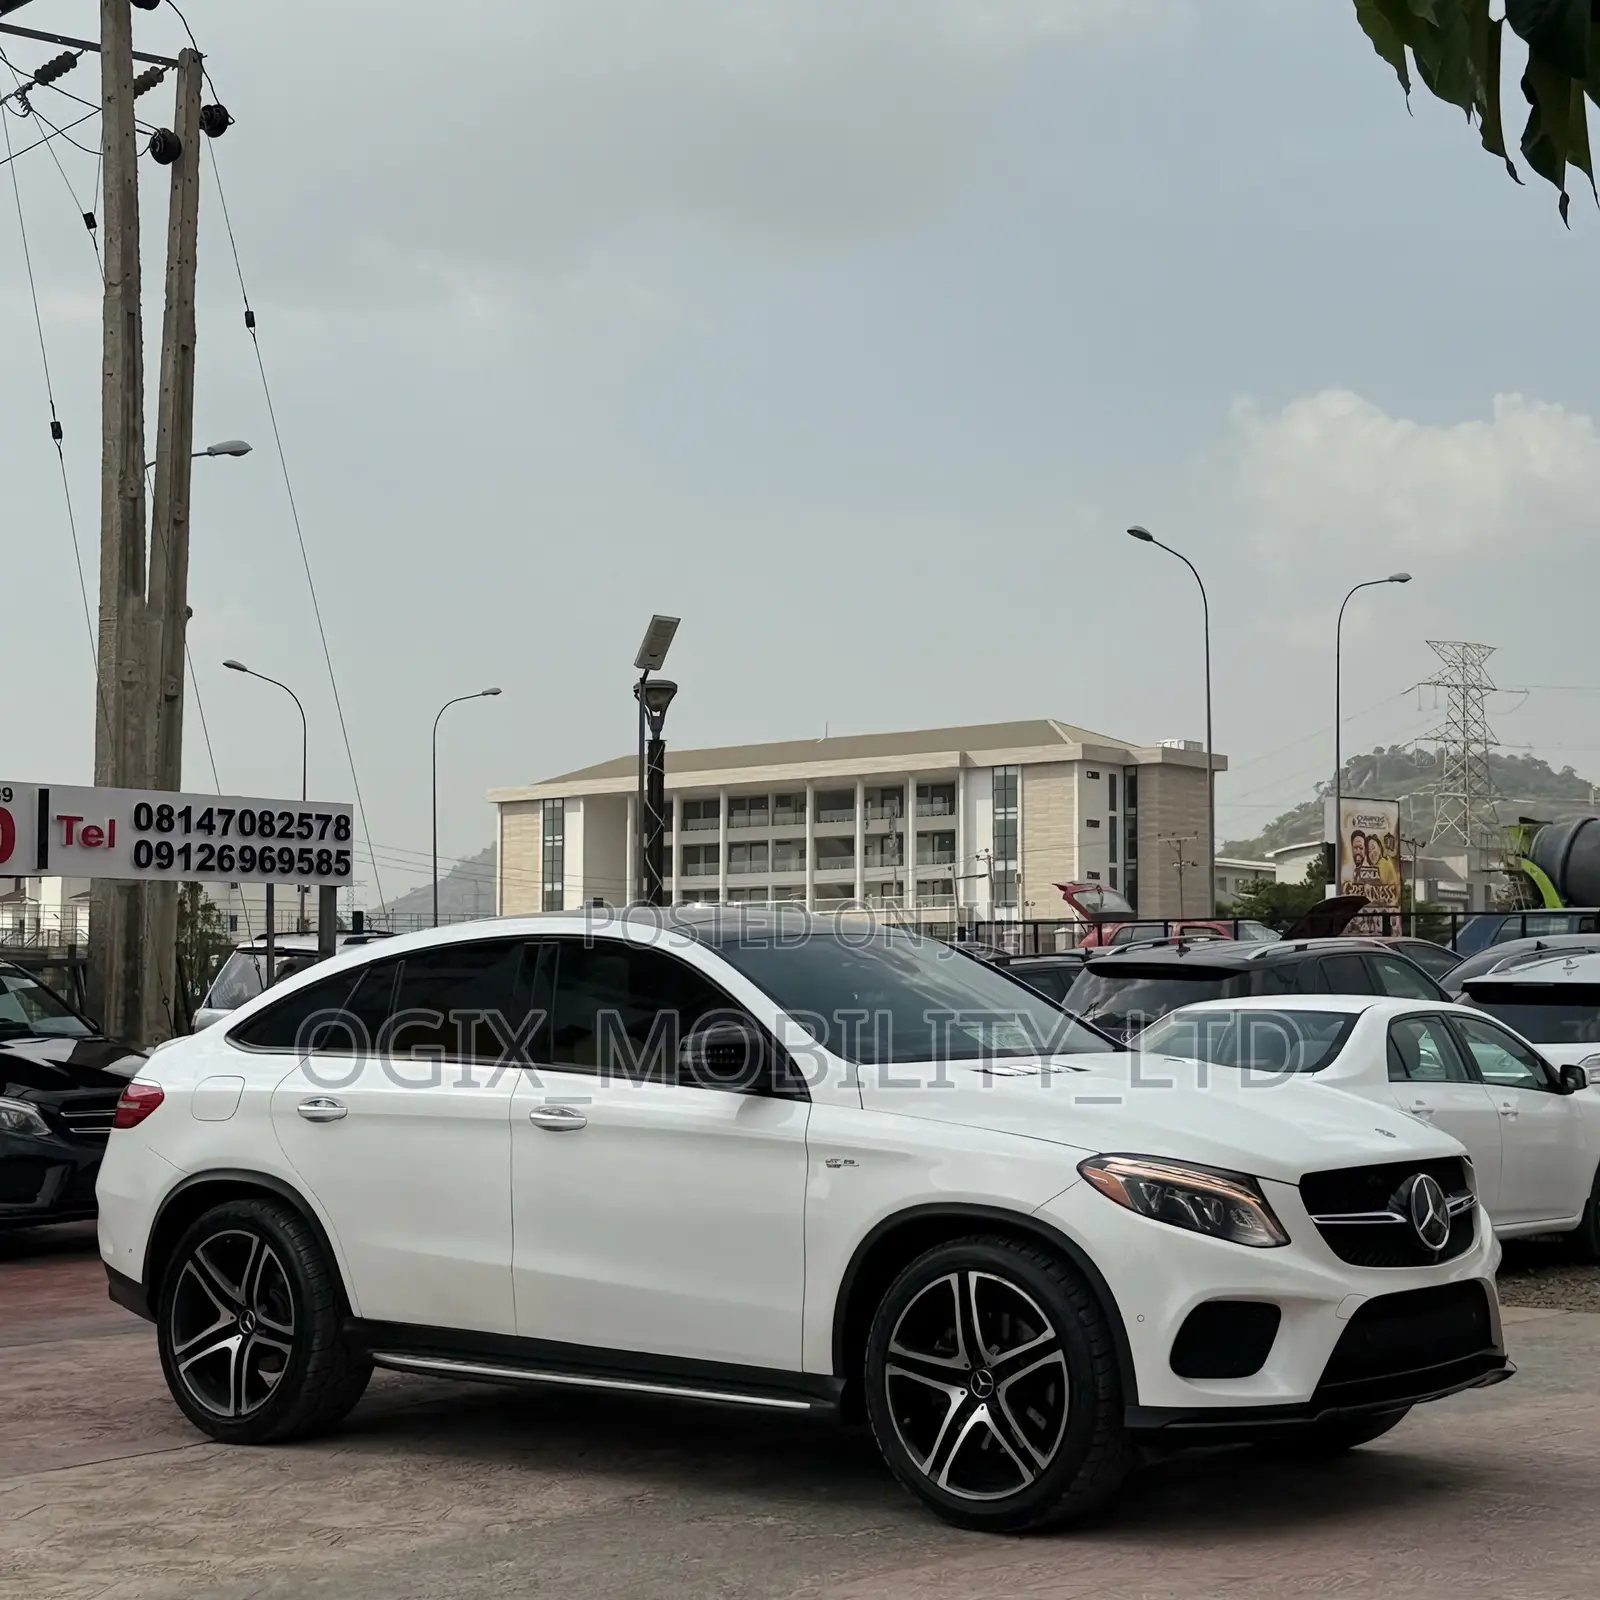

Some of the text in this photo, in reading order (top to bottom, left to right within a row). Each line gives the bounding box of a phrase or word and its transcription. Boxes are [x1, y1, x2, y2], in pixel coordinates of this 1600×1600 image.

[56, 814, 116, 849] Tel
[134, 802, 351, 842] 08147082578
[133, 839, 351, 876] 09126969585
